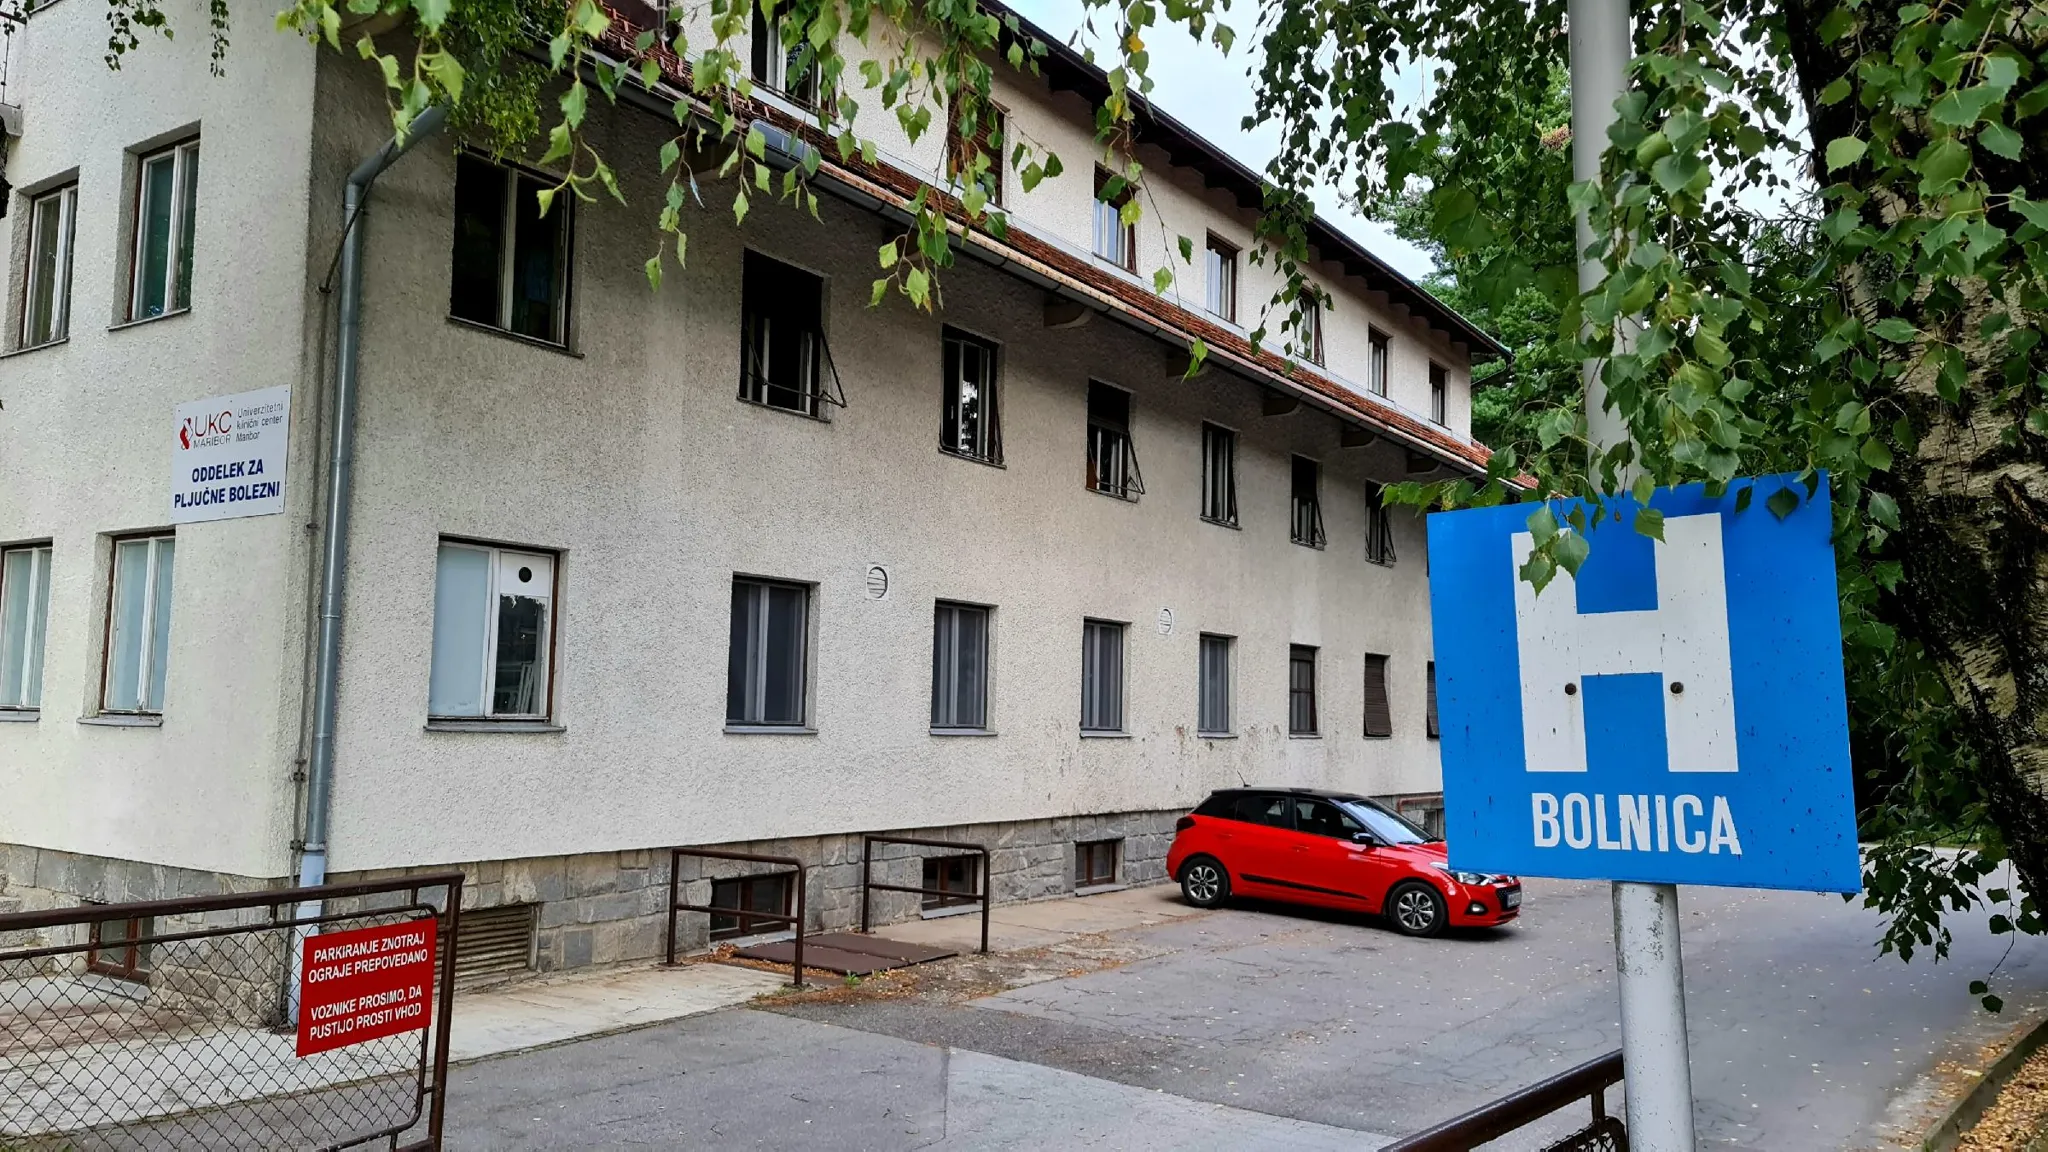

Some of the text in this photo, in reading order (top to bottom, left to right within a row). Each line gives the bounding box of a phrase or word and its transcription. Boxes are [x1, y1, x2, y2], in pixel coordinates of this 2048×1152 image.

[195, 410, 232, 437] UKC
[237, 401, 284, 418] Univerzitetni
[261, 415, 283, 426] center
[193, 434, 231, 449] MARIBOR
[235, 431, 260, 442] Maribor
[192, 459, 264, 483] ODDELEK ZA
[174, 481, 281, 509] PLJUČNE BOLEZNI
[1510, 512, 1739, 773] H
[1531, 792, 1743, 856] BOLNICA
[313, 931, 425, 964] PARKIRANJE ZNOTRAJ
[308, 948, 428, 984] OGRAJE PREPOVEDANO
[310, 984, 423, 1021] VOZNIKE PROSIMO, DA
[309, 1002, 422, 1041] PUSTIJO PROSTI VHOD
